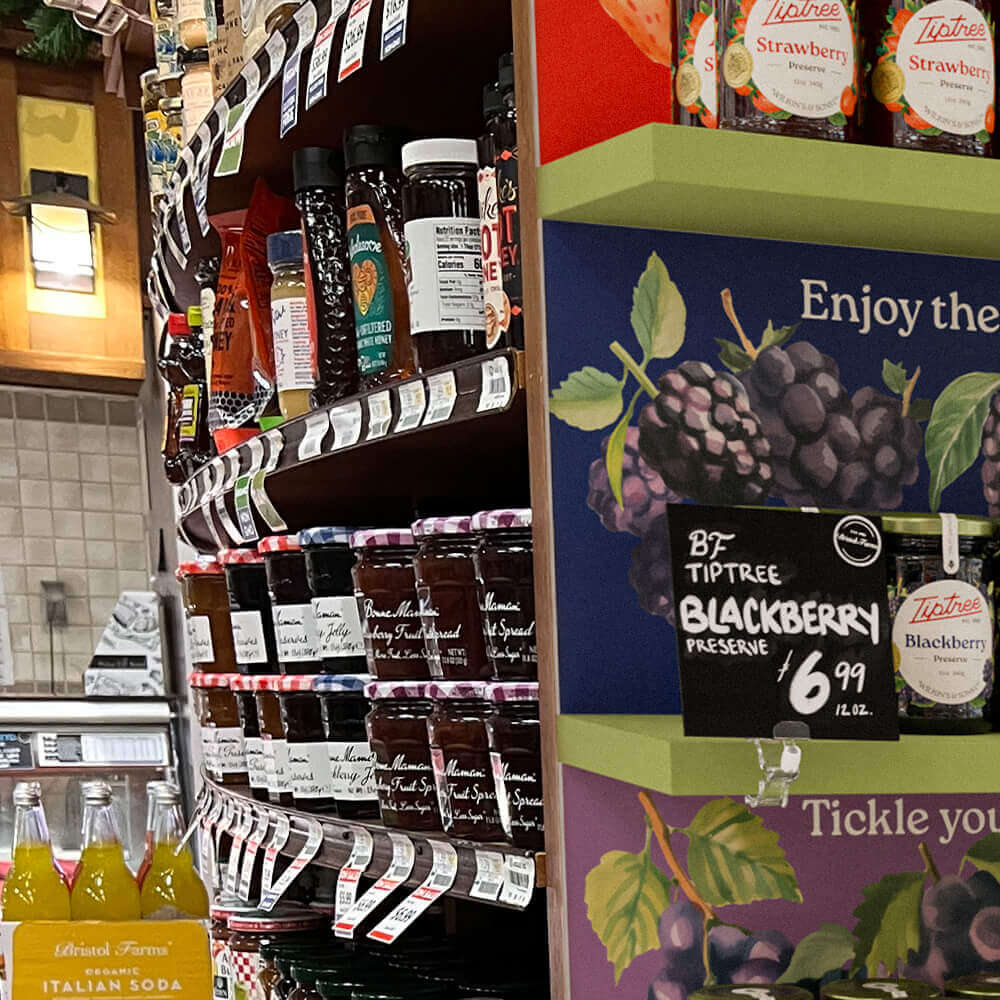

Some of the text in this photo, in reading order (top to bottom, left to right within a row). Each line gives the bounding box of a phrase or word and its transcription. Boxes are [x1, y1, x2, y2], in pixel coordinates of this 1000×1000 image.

[914, 14, 987, 44] Tiptree
[756, 36, 848, 66] Strawberry
[789, 60, 826, 74] Preserve
[909, 54, 991, 85] Strawberry
[438, 260, 464, 269] Calories
[800, 279, 923, 337] Enjoy
[932, 291, 1000, 333] the
[688, 529, 736, 560] BF
[684, 562, 782, 586] TIPTREE
[908, 592, 983, 625] Tiptree
[500, 618, 536, 641] Spread
[679, 595, 880, 646] BLACKBERRY
[686, 638, 769, 656] PRESERVE
[905, 633, 987, 653] Blackberry
[934, 654, 968, 664] Preserve
[836, 703, 849, 716] 12
[802, 797, 929, 837] Tickle
[54, 940, 169, 957] Bristol Farms
[42, 978, 182, 993] ITALIAN SODA
